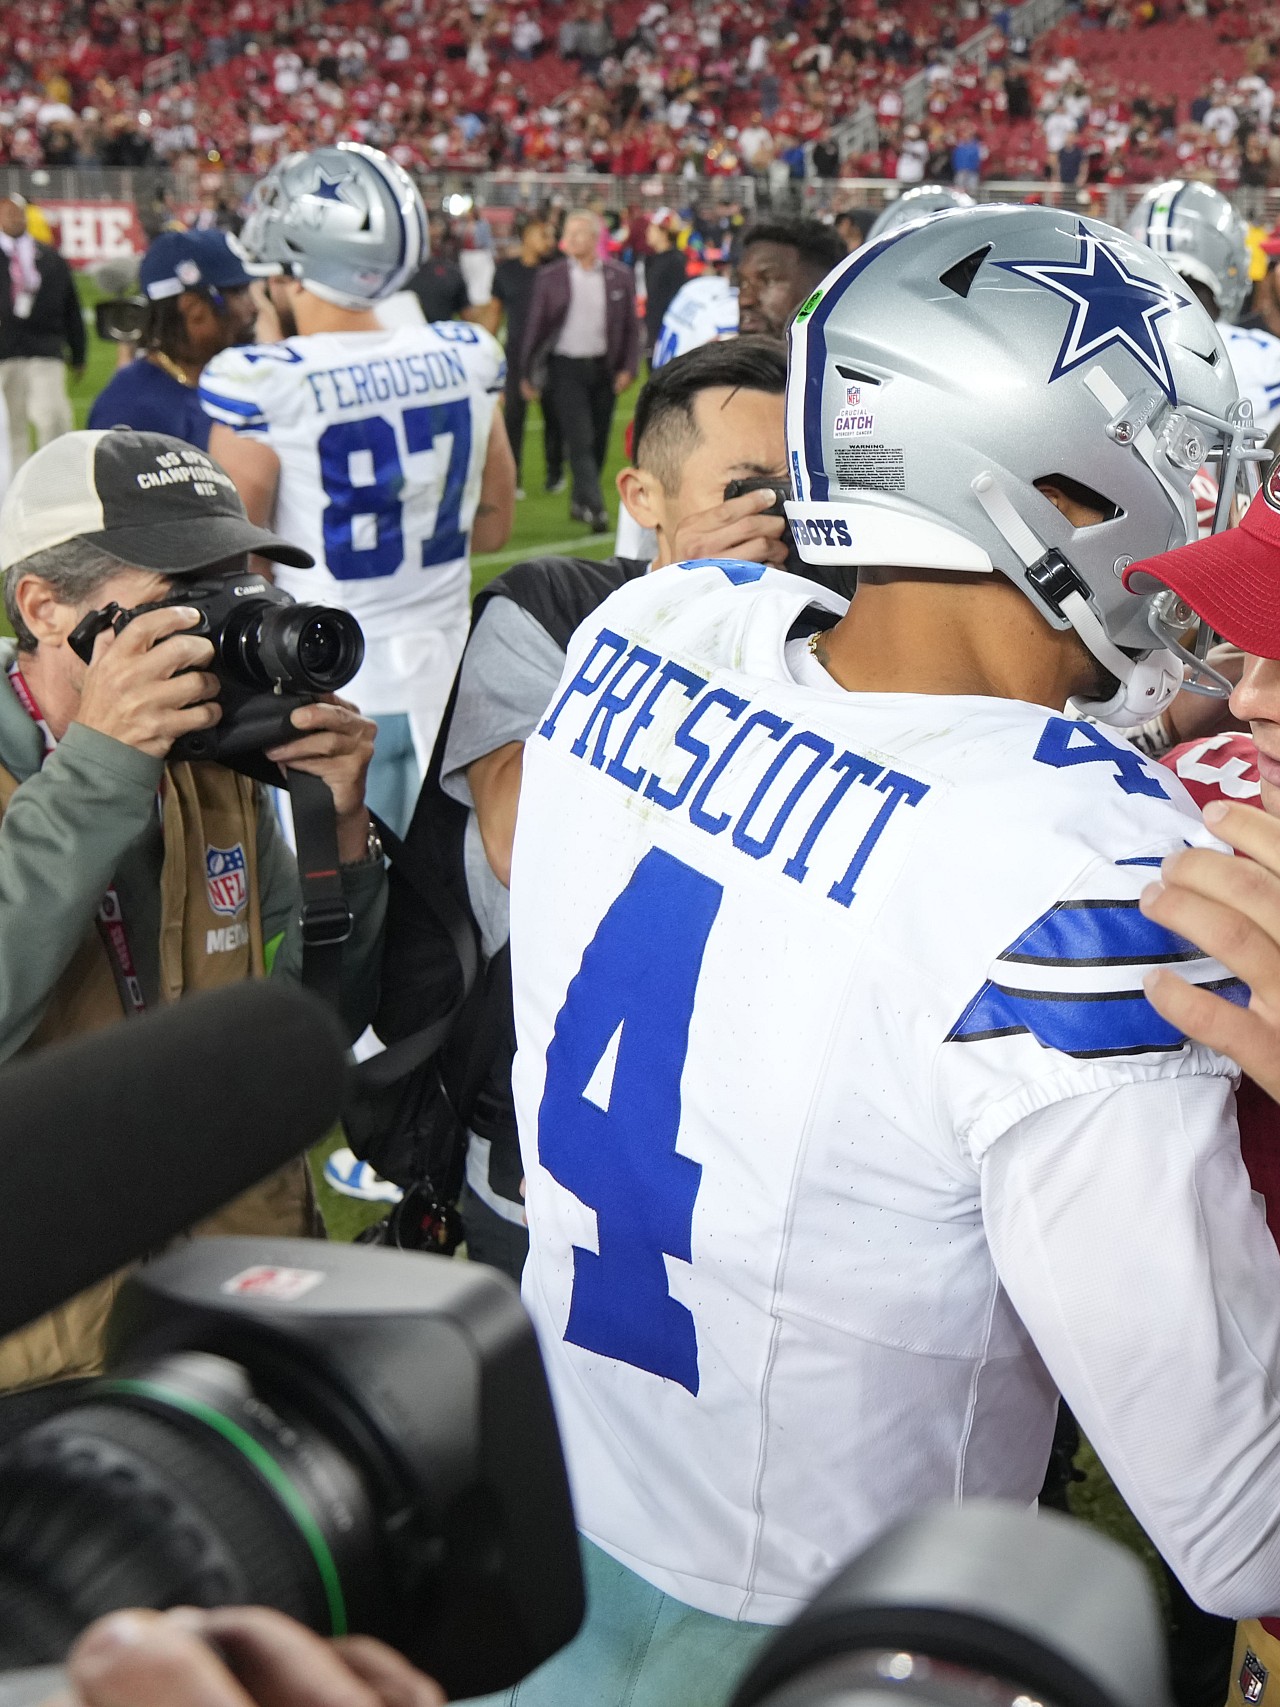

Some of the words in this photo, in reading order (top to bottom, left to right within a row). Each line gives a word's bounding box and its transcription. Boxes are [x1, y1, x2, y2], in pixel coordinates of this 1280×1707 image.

[307, 349, 468, 413] FERGUSON
[848, 394, 859, 404] NFL
[835, 415, 874, 431] CATCH
[840, 408, 868, 417] CRUCIAL
[155, 451, 182, 469] US
[193, 481, 218, 497] NYC
[317, 397, 472, 582] 87
[233, 584, 266, 597] Canon
[538, 627, 931, 908] PRESCOTT
[1033, 716, 1172, 800] 4
[208, 872, 247, 907] NFL
[537, 845, 724, 1397] 4
